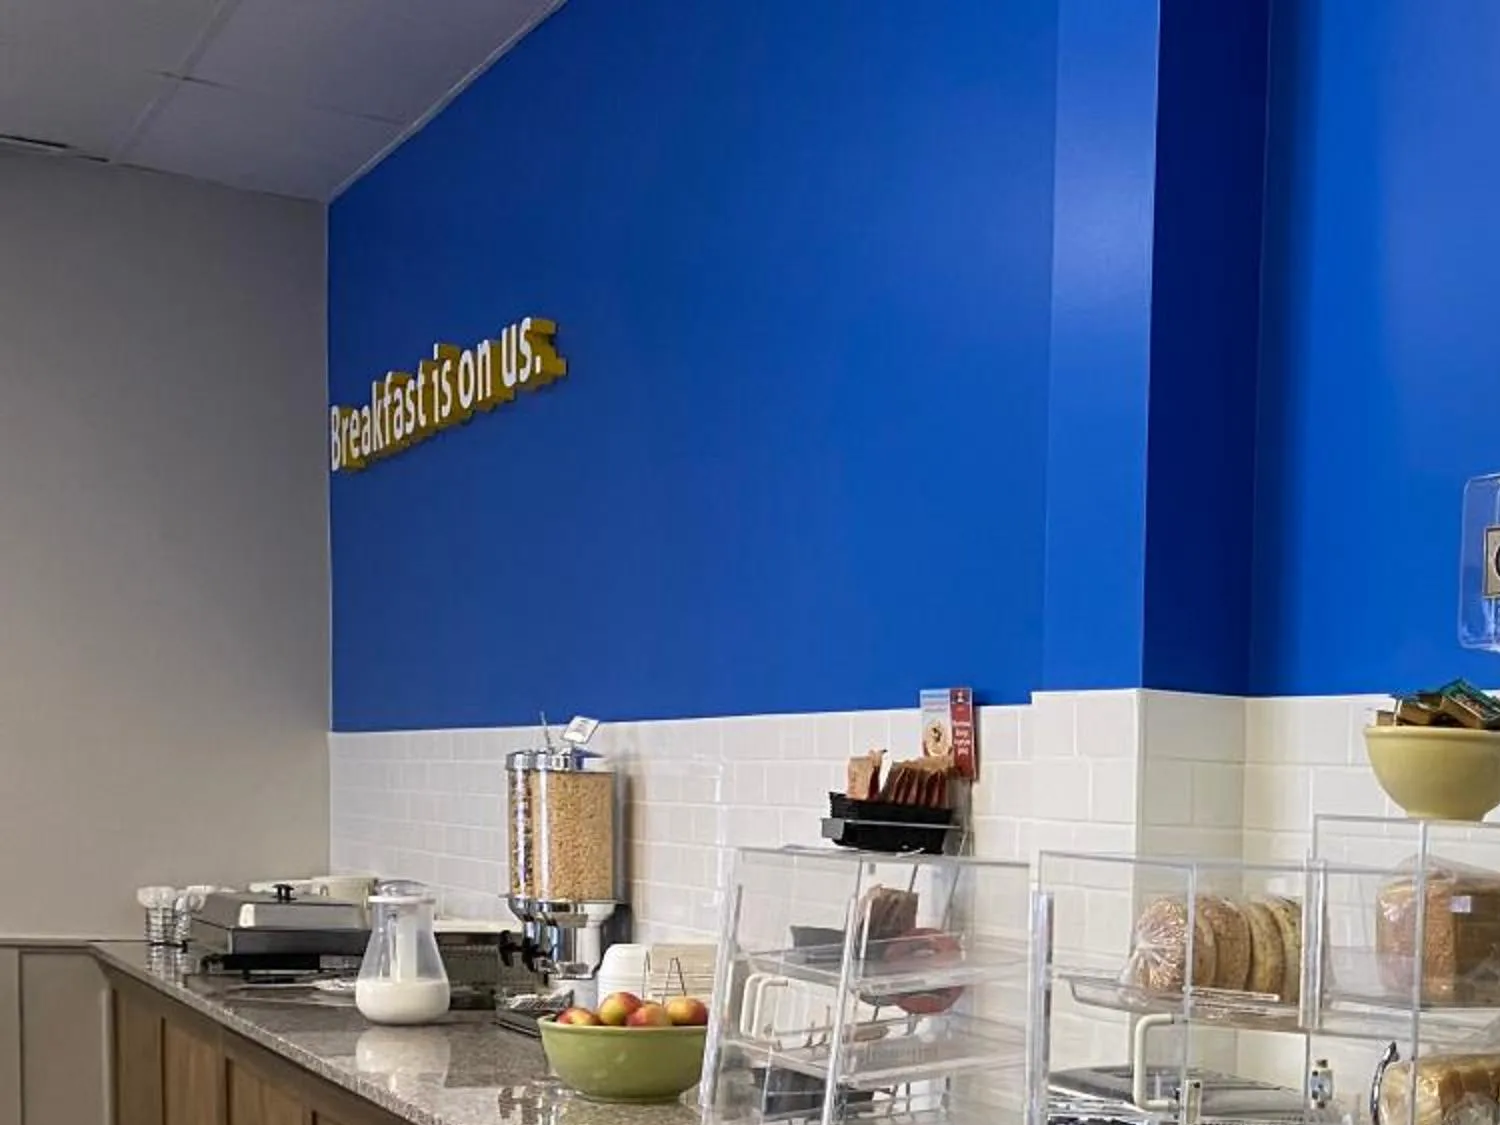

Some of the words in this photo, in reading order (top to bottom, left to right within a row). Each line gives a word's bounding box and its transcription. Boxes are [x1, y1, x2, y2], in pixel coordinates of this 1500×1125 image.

[331, 359, 427, 471] Breakfast
[432, 342, 452, 423] is
[458, 339, 492, 409] on
[501, 316, 543, 387] us.
